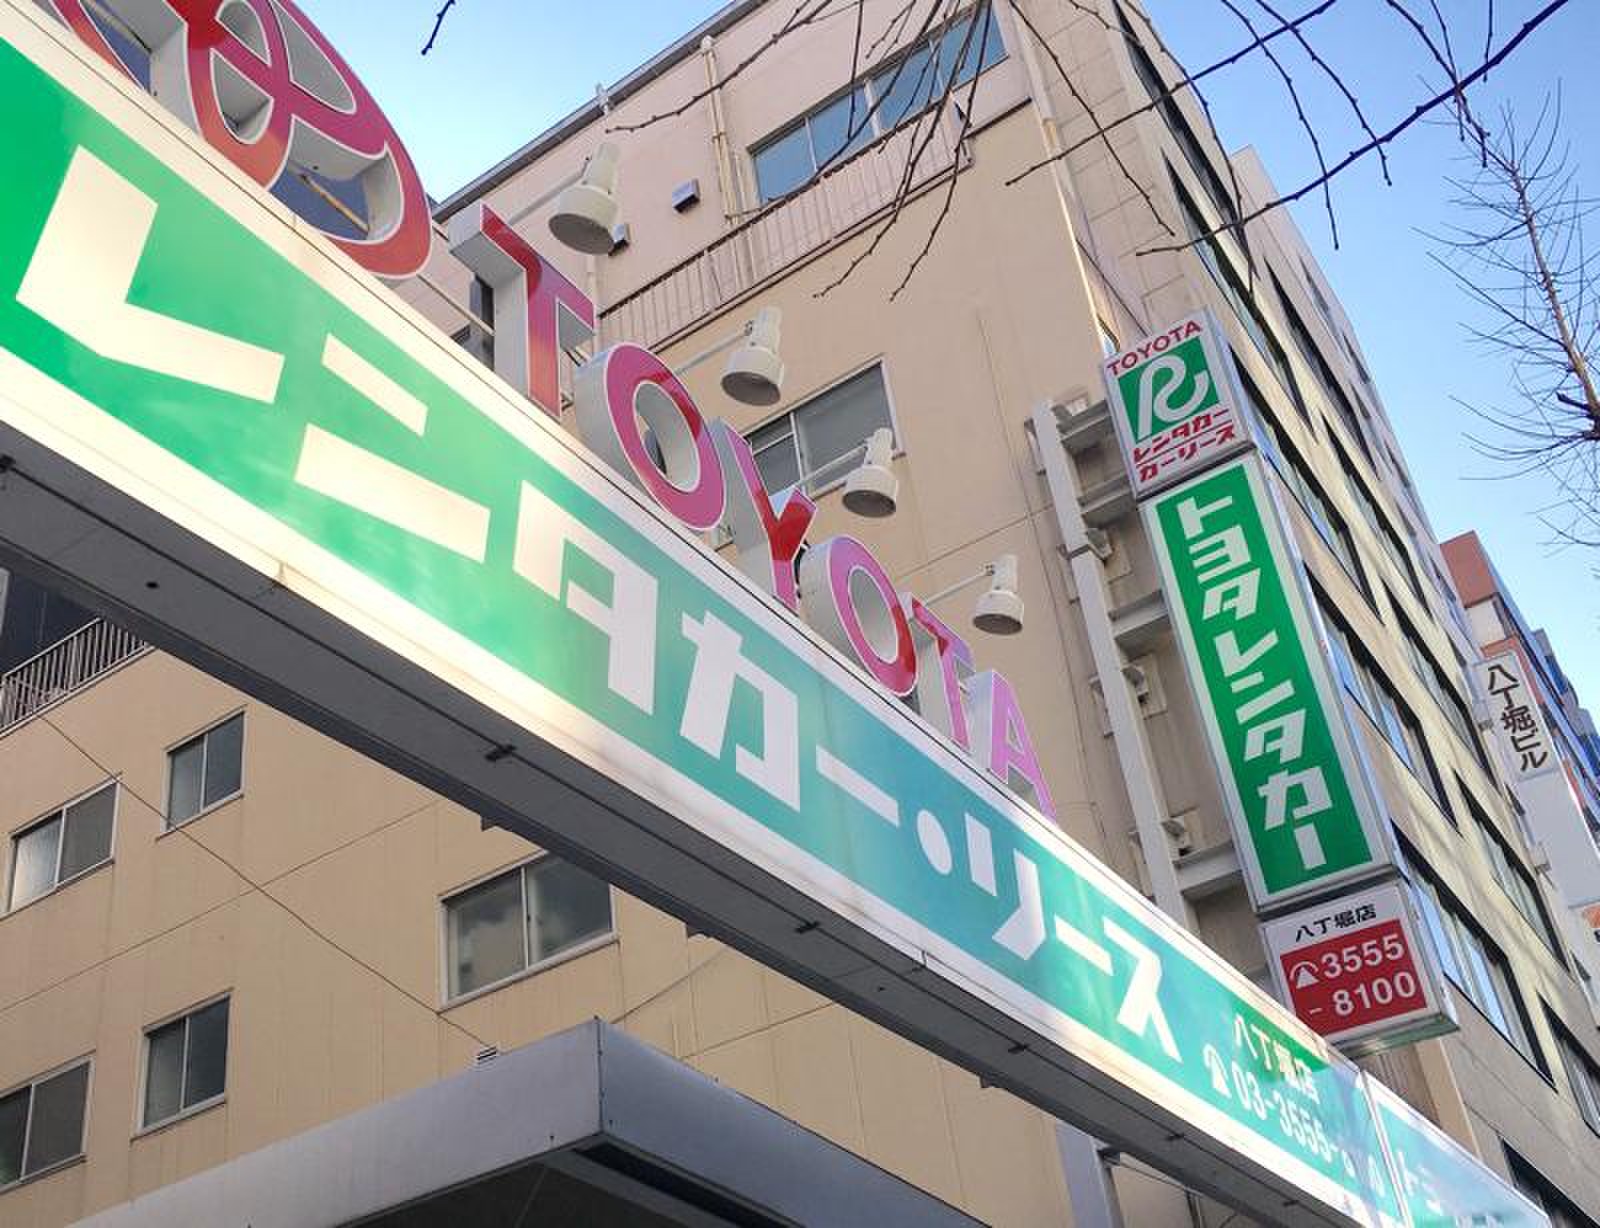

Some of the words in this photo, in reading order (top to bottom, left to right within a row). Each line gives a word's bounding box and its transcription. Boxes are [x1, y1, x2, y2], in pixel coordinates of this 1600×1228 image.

[1107, 320, 1204, 375] TOYOTA
[1133, 408, 1230, 464] レンタカー
[1140, 425, 1235, 482] カーリース
[478, 203, 1057, 825] TOYOTA
[1177, 495, 1333, 870] トヨタレンタカー
[1487, 664, 1548, 772] 八丁堀ビル
[1295, 903, 1377, 942] 八丁堀店
[1321, 933, 1405, 979] 3555
